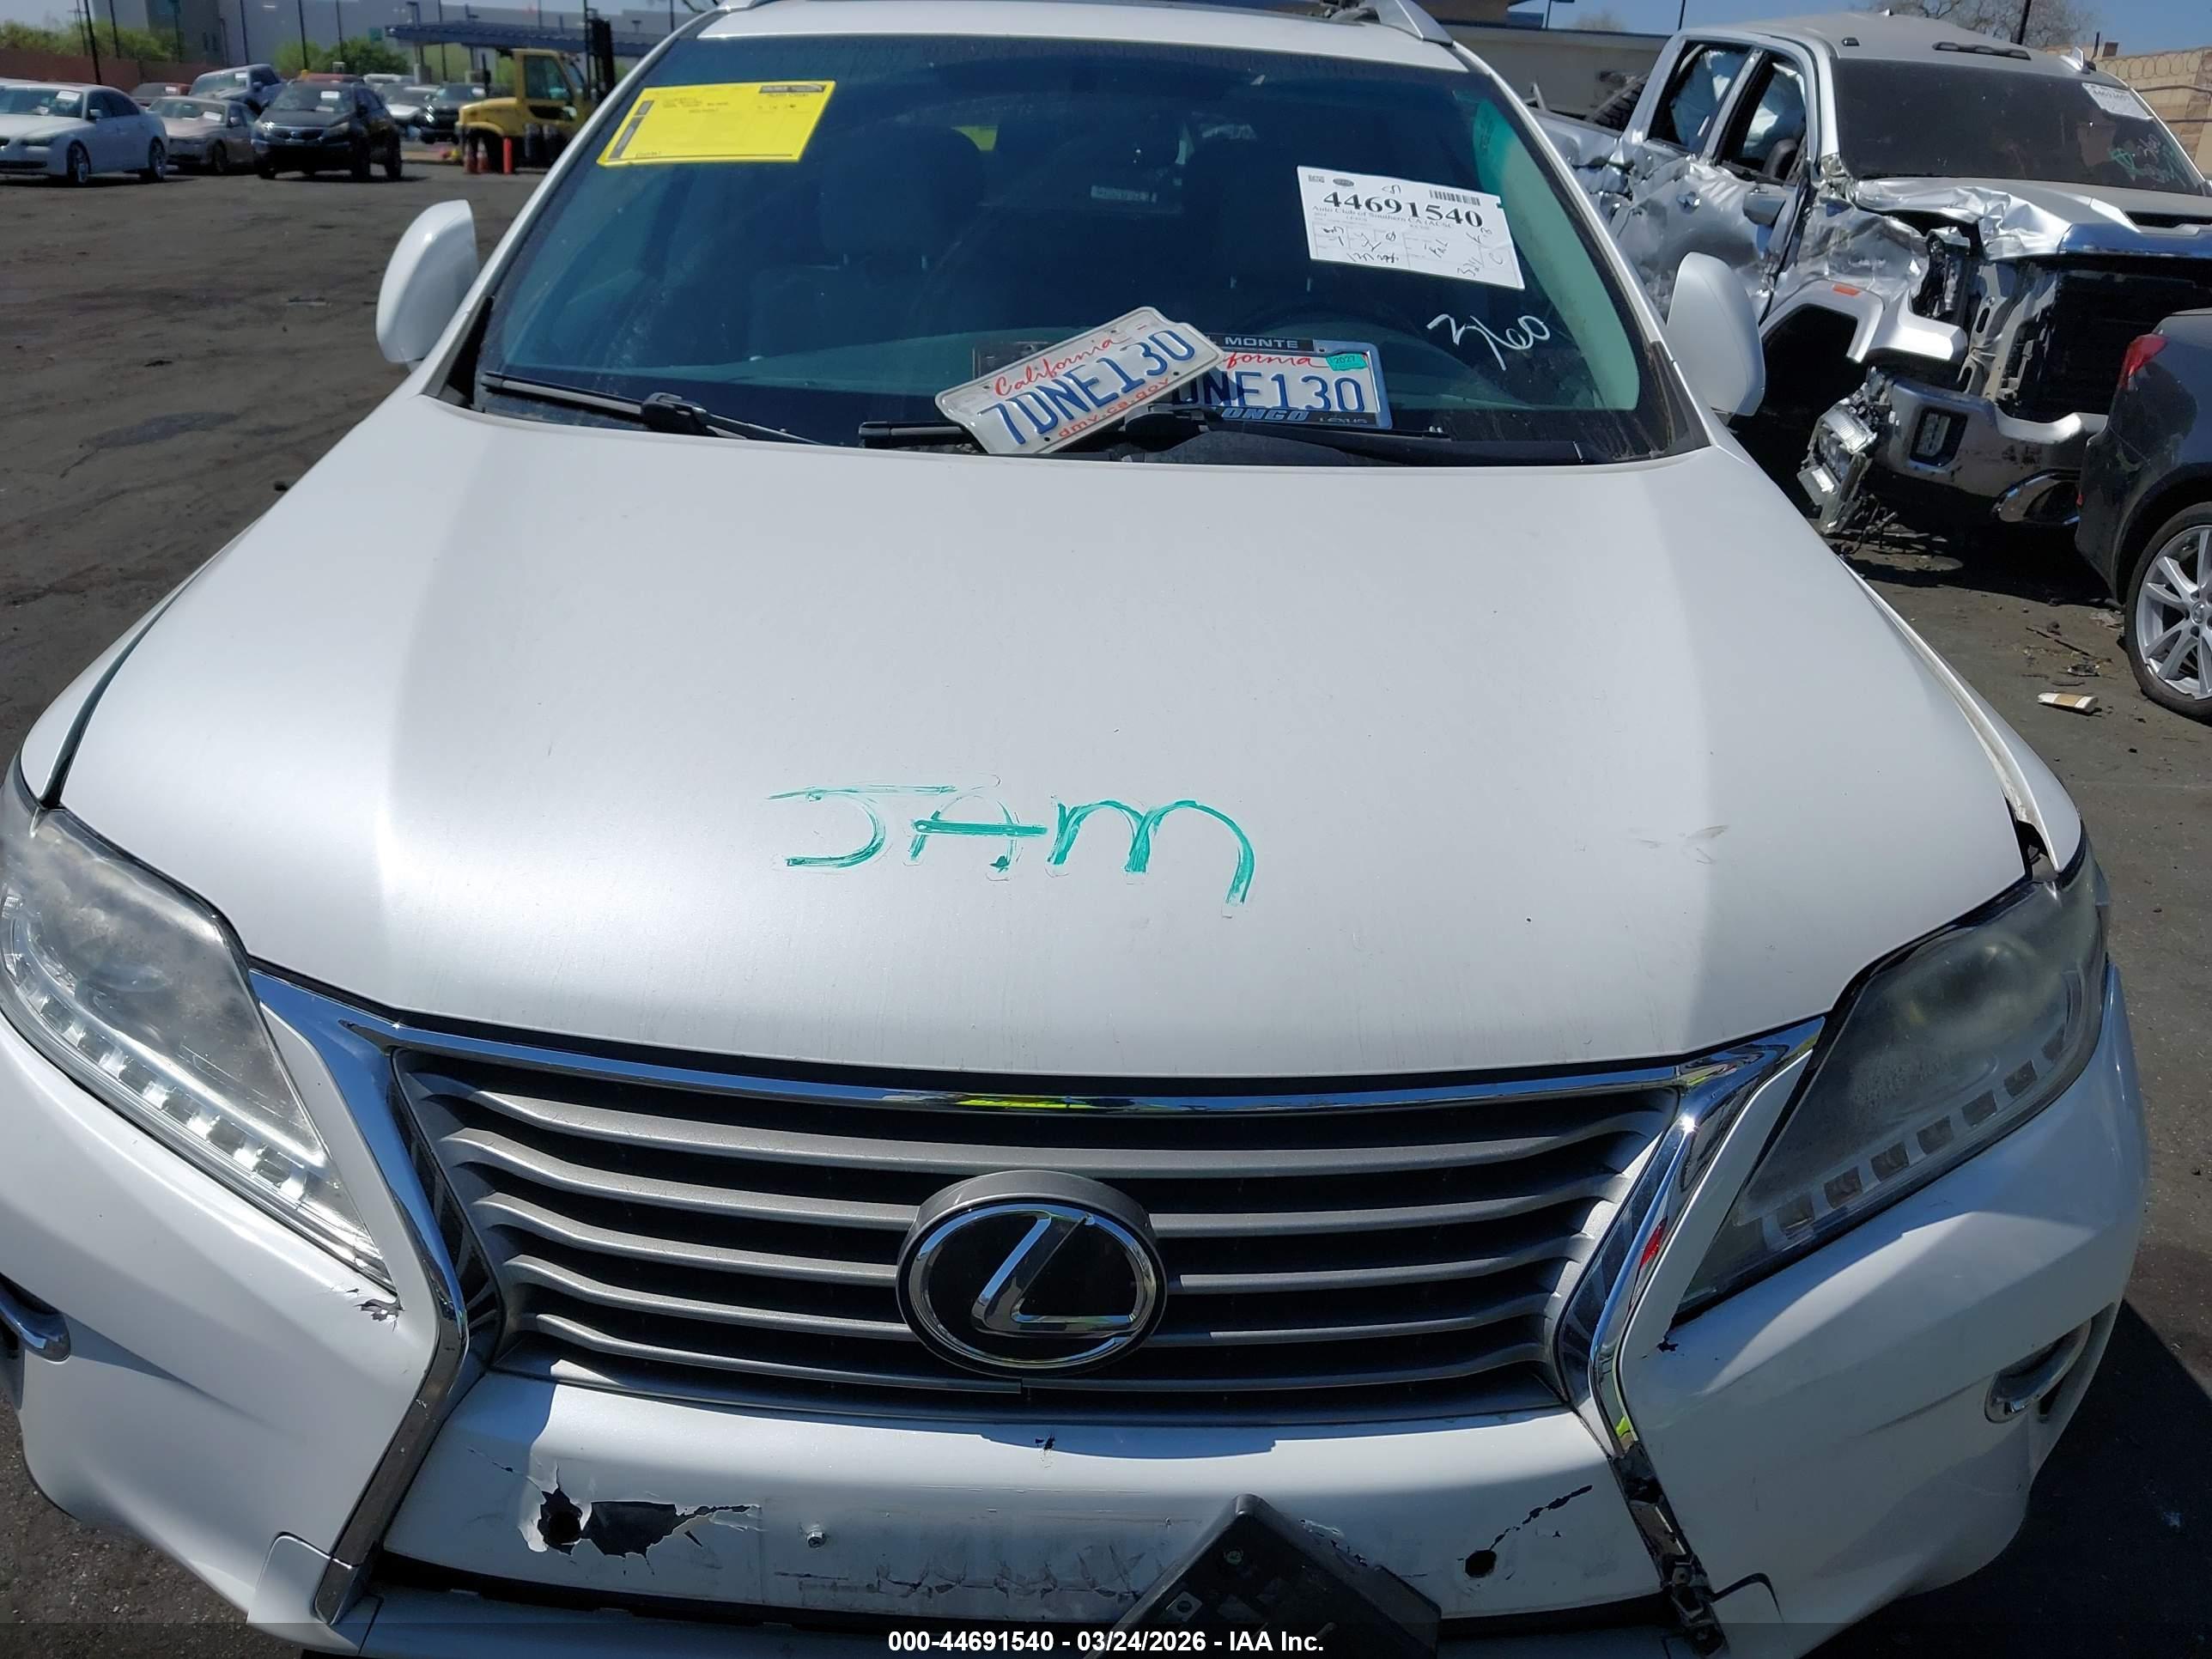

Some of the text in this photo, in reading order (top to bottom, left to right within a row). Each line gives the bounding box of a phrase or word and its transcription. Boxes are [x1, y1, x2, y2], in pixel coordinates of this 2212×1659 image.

[1323, 191, 1483, 228] 44691540
[1223, 351, 1329, 369] fornia
[1224, 337, 1298, 349] MONTE
[1334, 356, 1355, 364] 2027
[994, 337, 1133, 396] California
[977, 330, 1195, 445] 7DNE130
[1170, 371, 1364, 412] DNE130
[1059, 378, 1169, 438] dmv.ca.gov
[1220, 406, 1310, 422] ONGO
